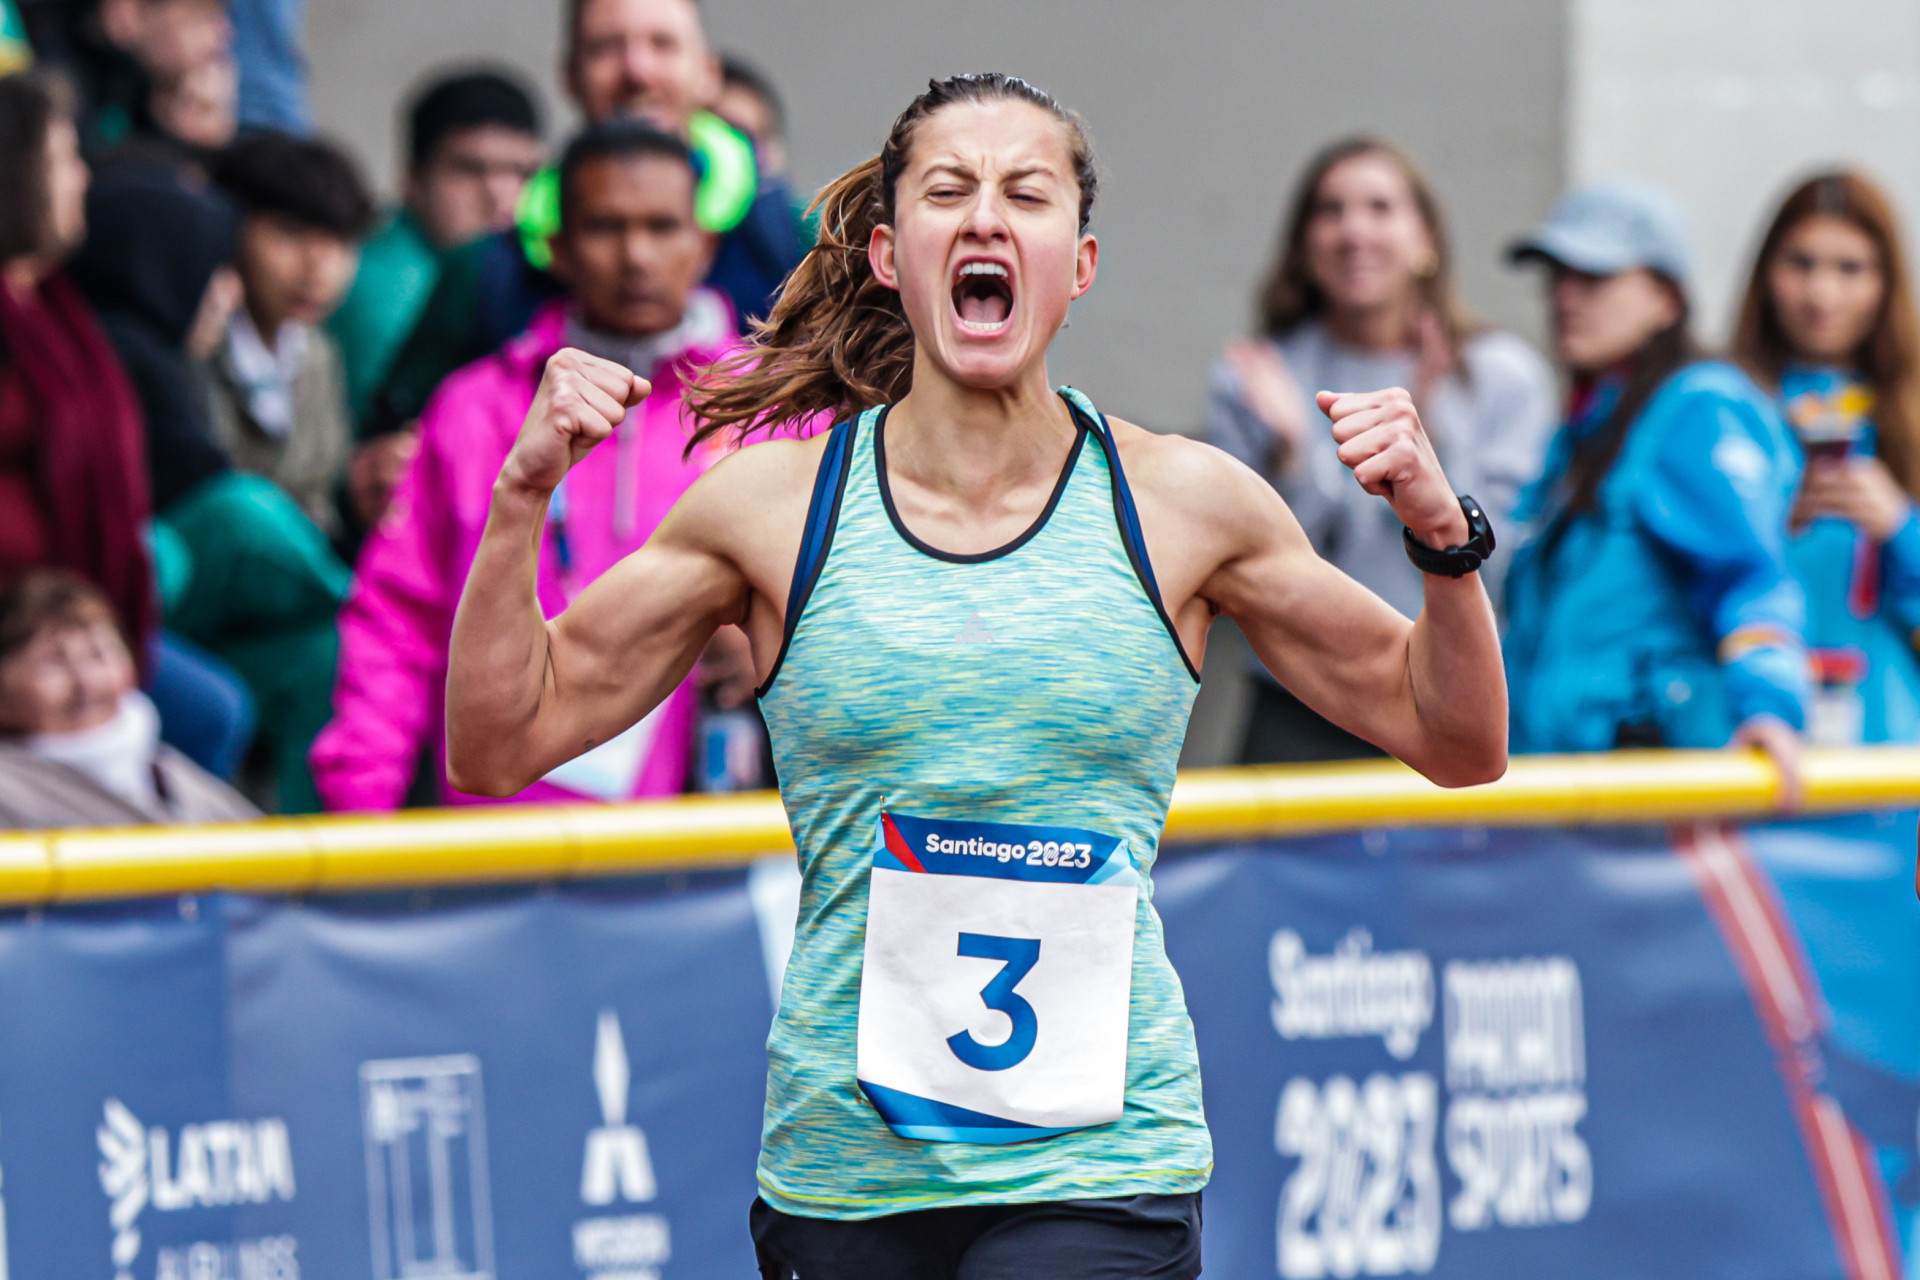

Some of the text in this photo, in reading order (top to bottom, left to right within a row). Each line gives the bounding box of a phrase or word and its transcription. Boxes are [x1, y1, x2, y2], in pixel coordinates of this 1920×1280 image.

[925, 833, 1093, 869] Santiago 2023
[946, 931, 1041, 1071] 3
[1269, 927, 1434, 1059] Stigo
